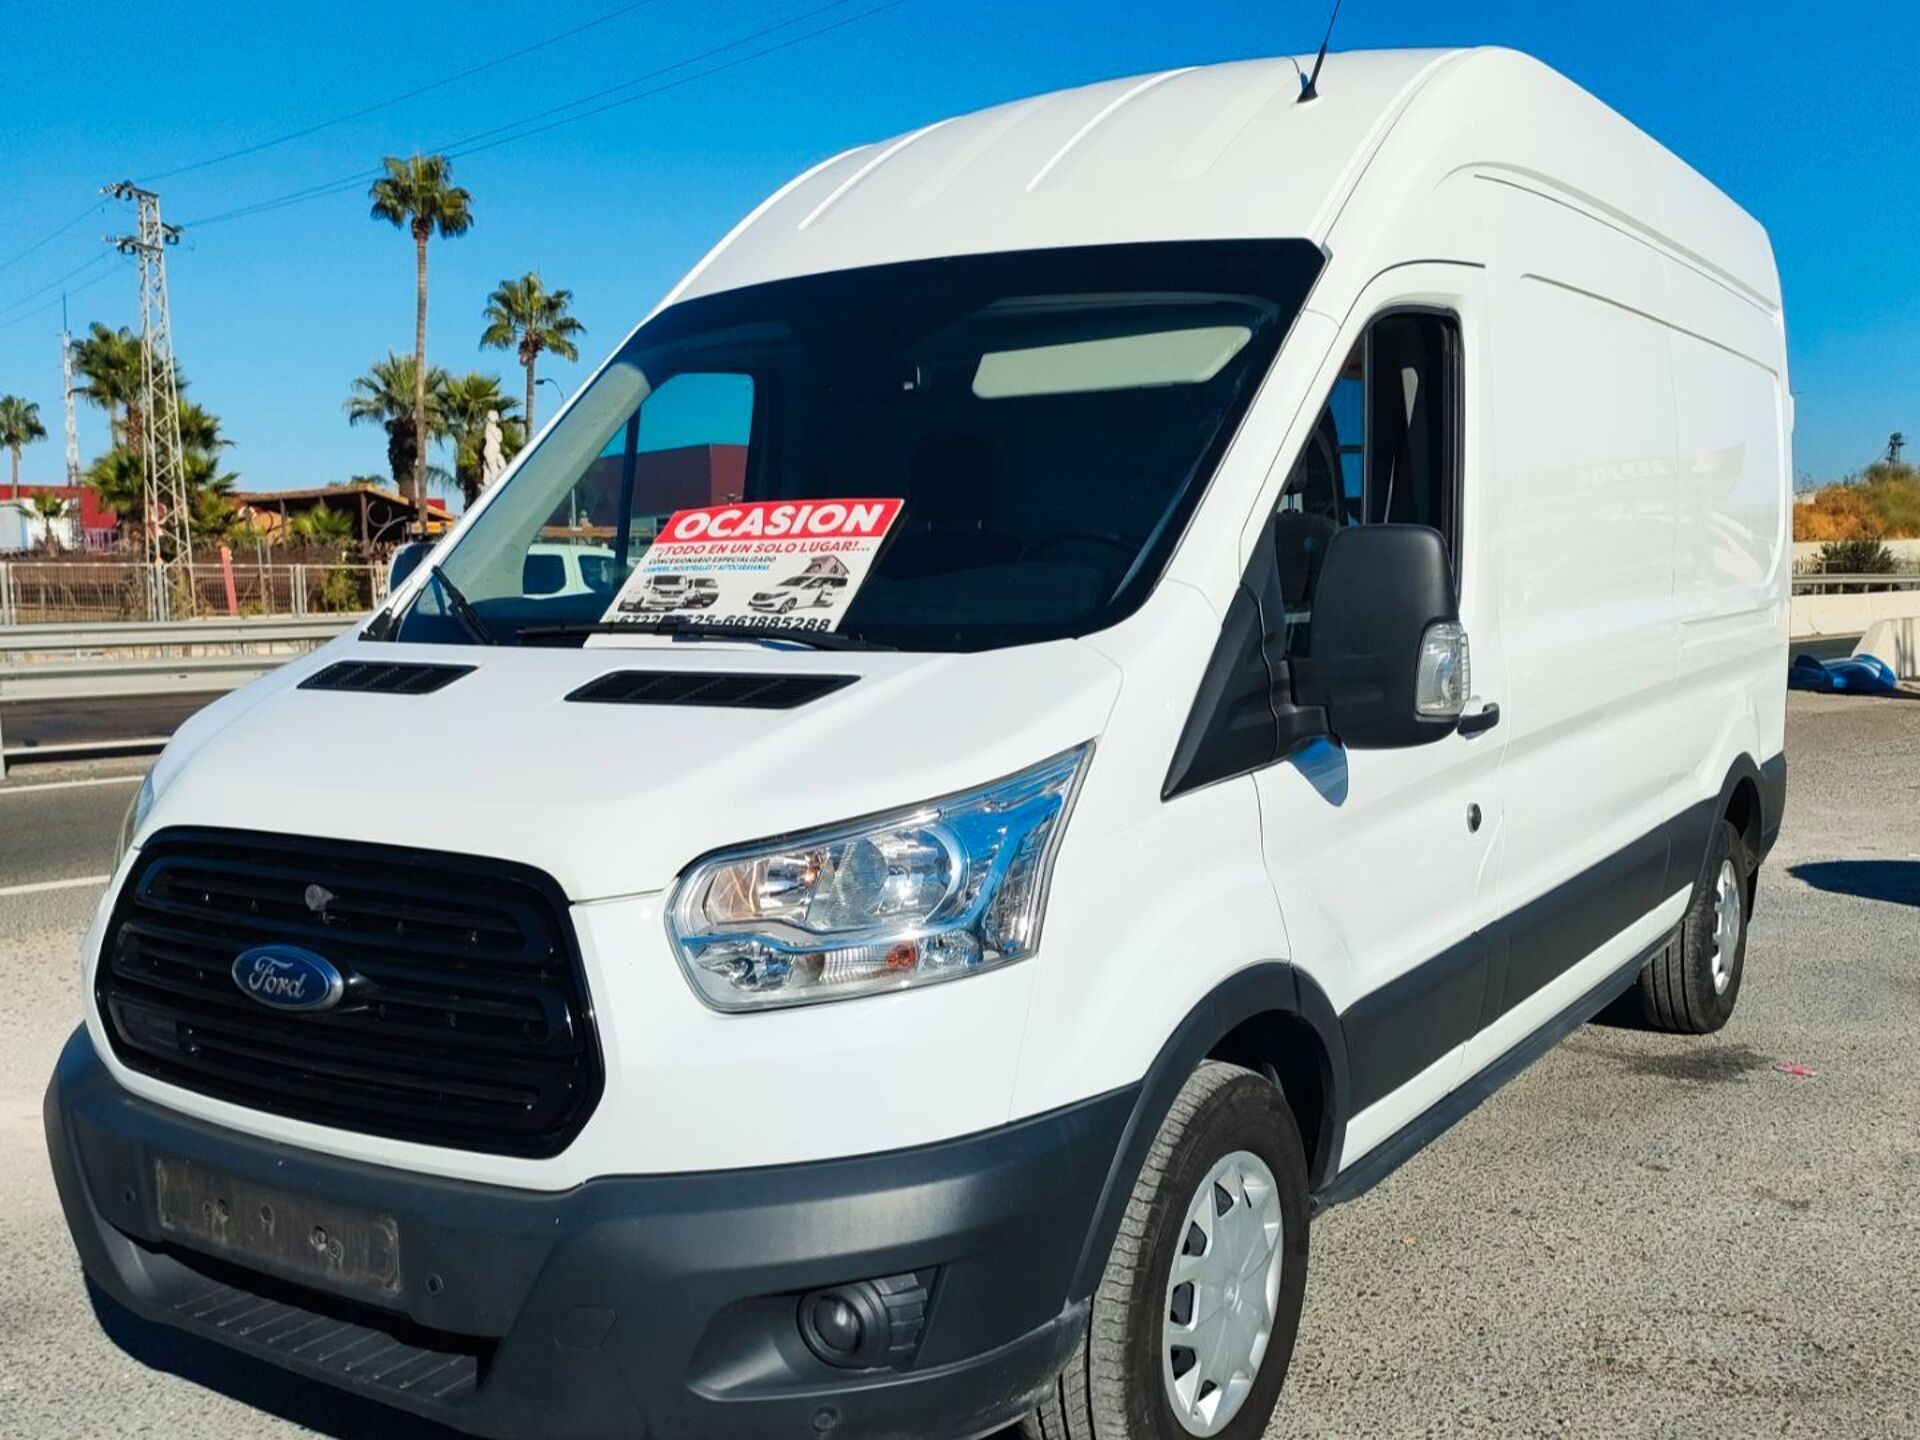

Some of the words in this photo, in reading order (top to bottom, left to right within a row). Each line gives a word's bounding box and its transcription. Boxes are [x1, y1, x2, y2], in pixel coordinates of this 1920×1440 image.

[674, 503, 885, 540] OCASION
[708, 544, 729, 555] EN
[730, 543, 752, 554] UN
[754, 543, 797, 554] SOLO
[248, 955, 308, 999] Ford
